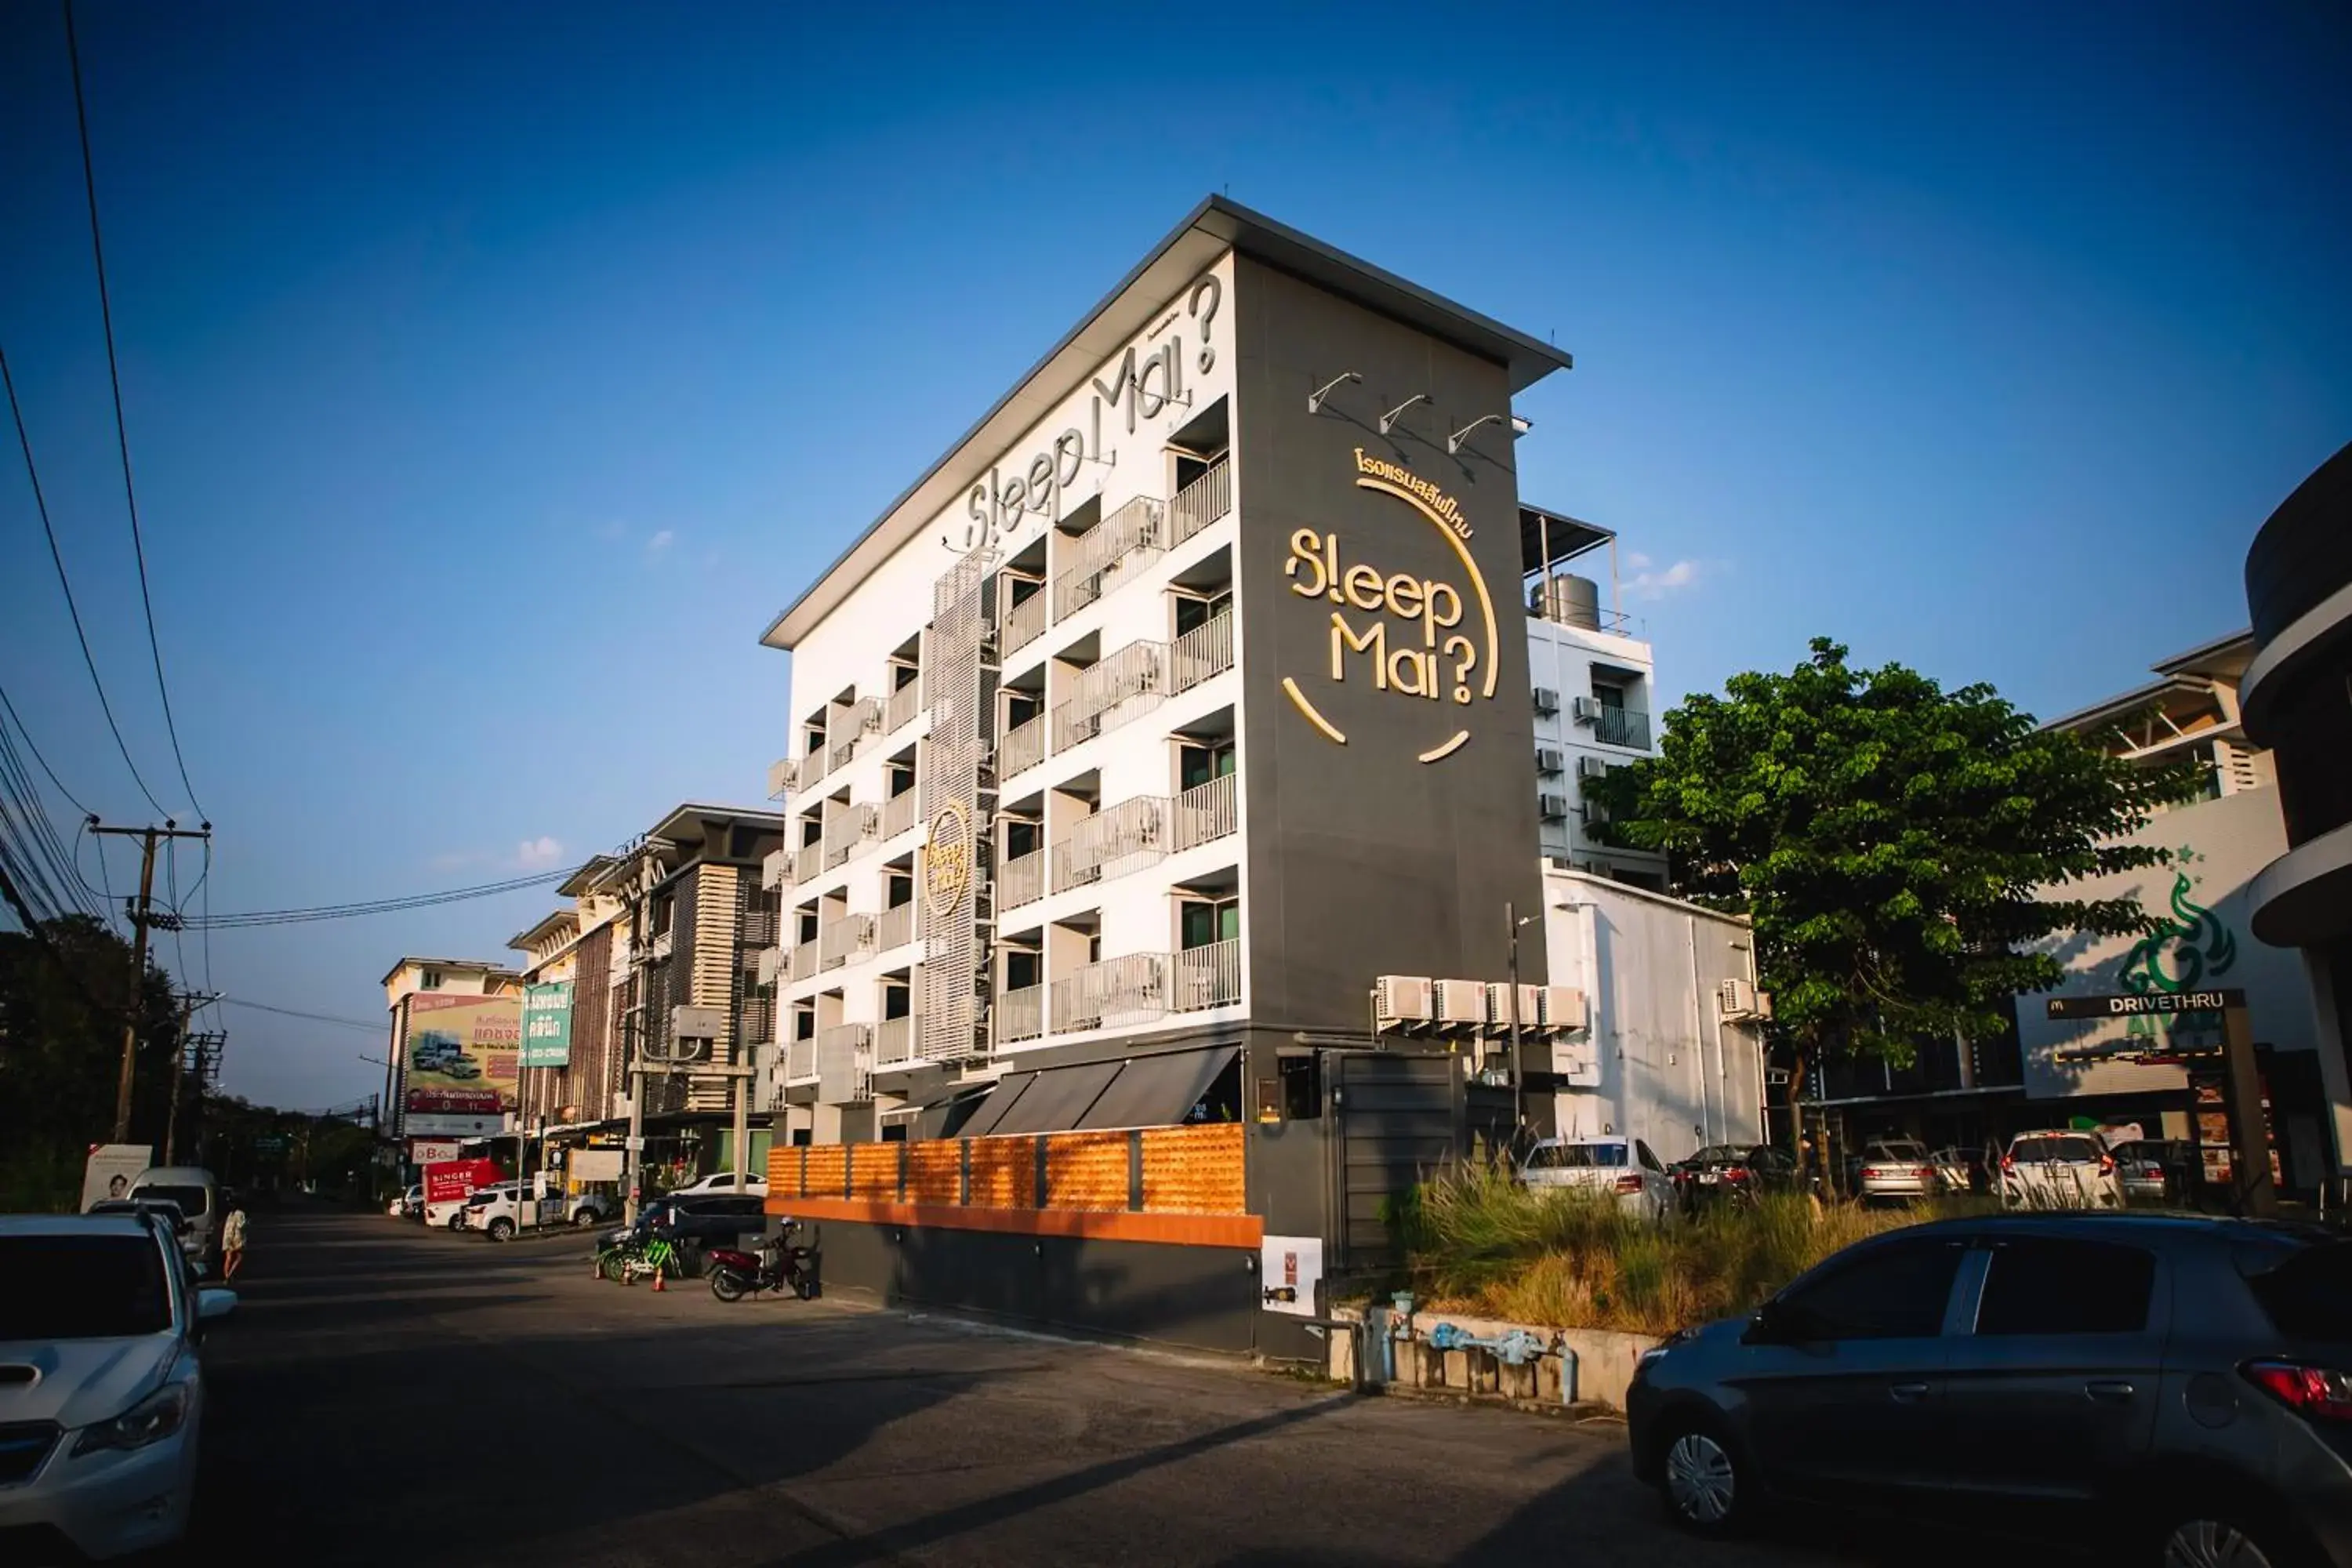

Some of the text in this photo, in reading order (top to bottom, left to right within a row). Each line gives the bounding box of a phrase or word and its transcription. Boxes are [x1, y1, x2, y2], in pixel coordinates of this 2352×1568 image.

[965, 429, 1083, 549] Sleep
[1285, 528, 1462, 648] Sleep
[1330, 613, 1476, 704] Mai?
